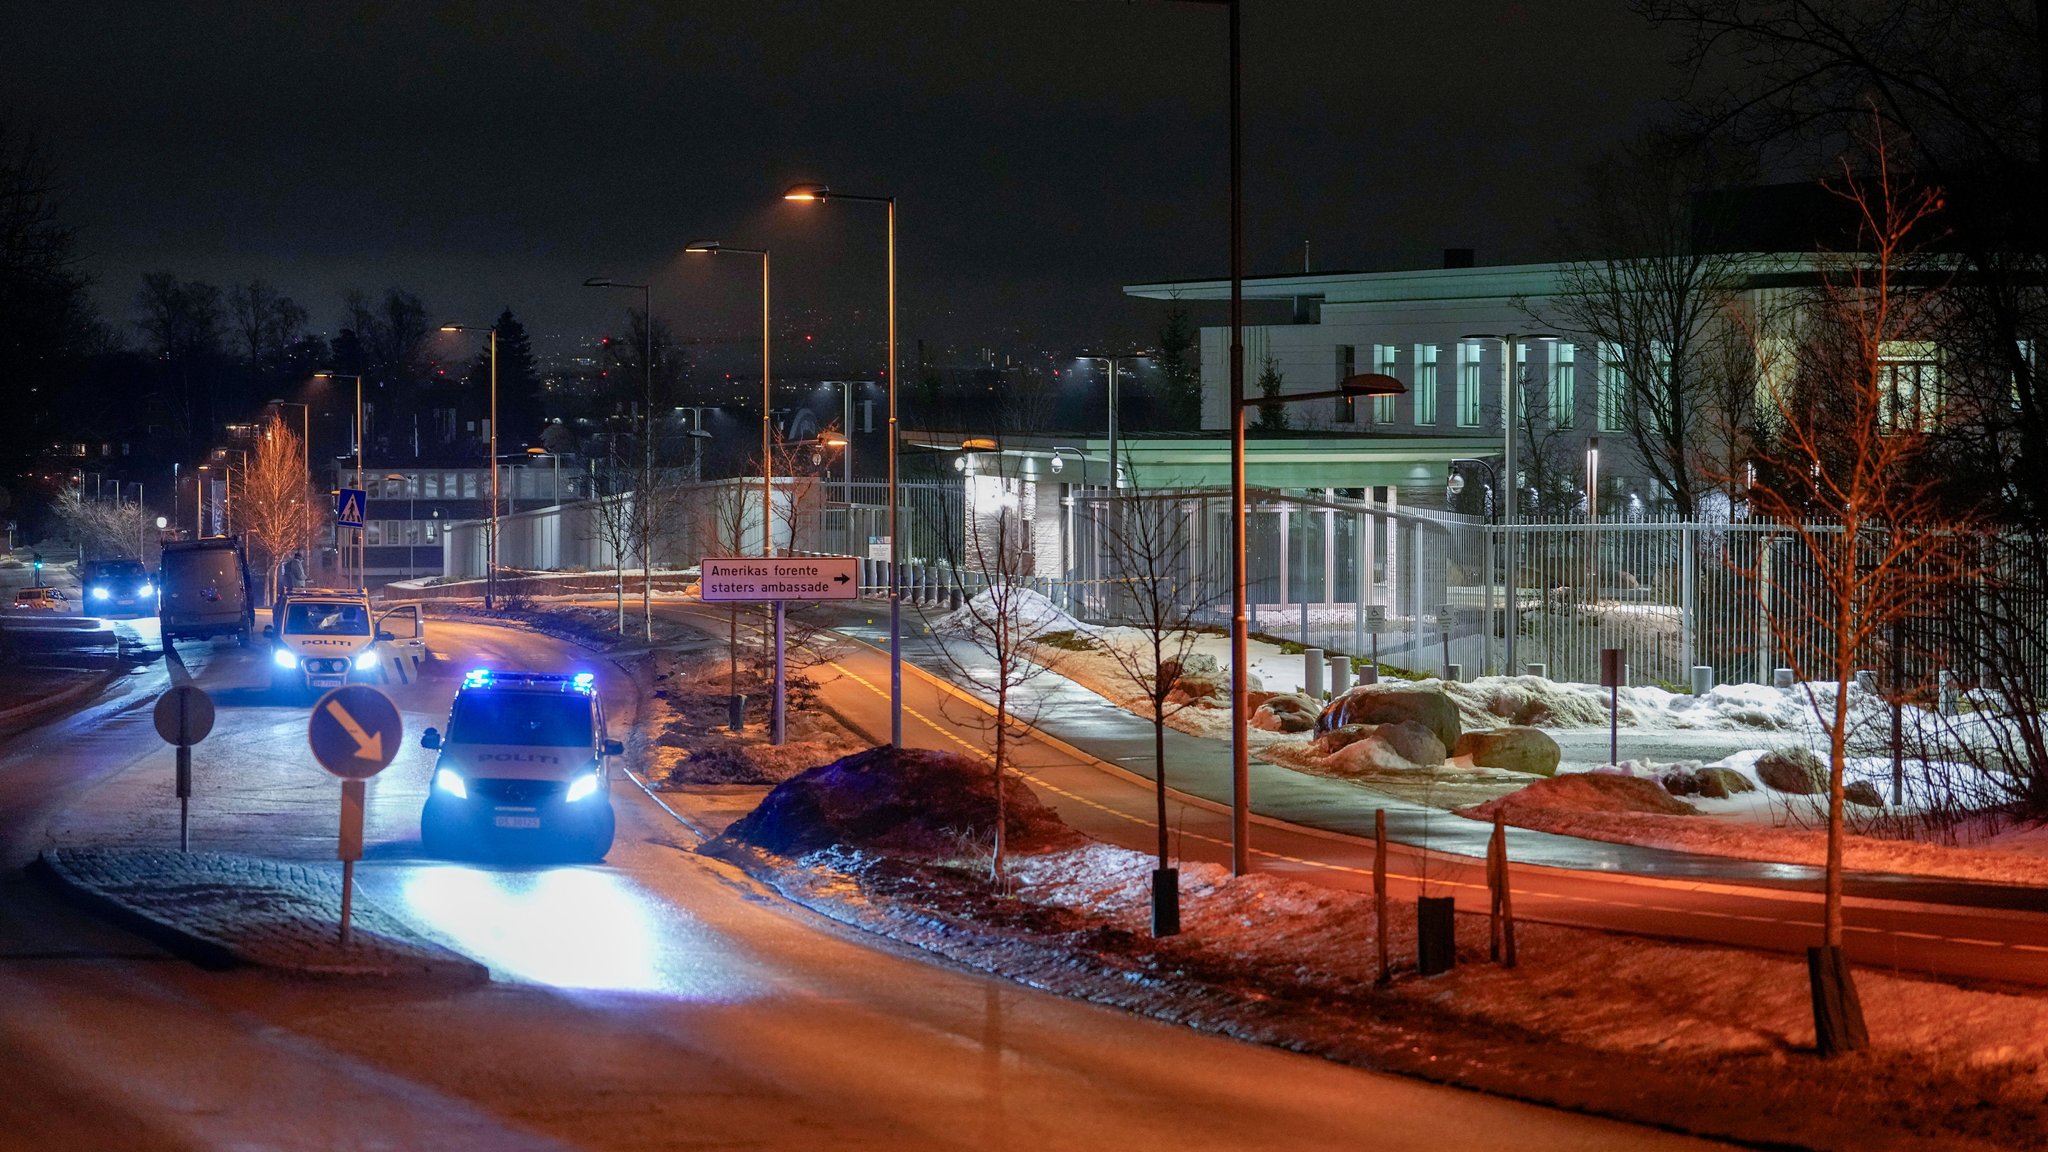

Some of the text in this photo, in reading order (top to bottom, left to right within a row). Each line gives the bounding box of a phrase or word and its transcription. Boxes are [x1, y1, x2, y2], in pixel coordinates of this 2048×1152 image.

[711, 565, 818, 576] Amerikas forente
[711, 581, 829, 593] staters ambassade
[301, 639, 351, 647] POLITI
[477, 753, 559, 765] POLITI
